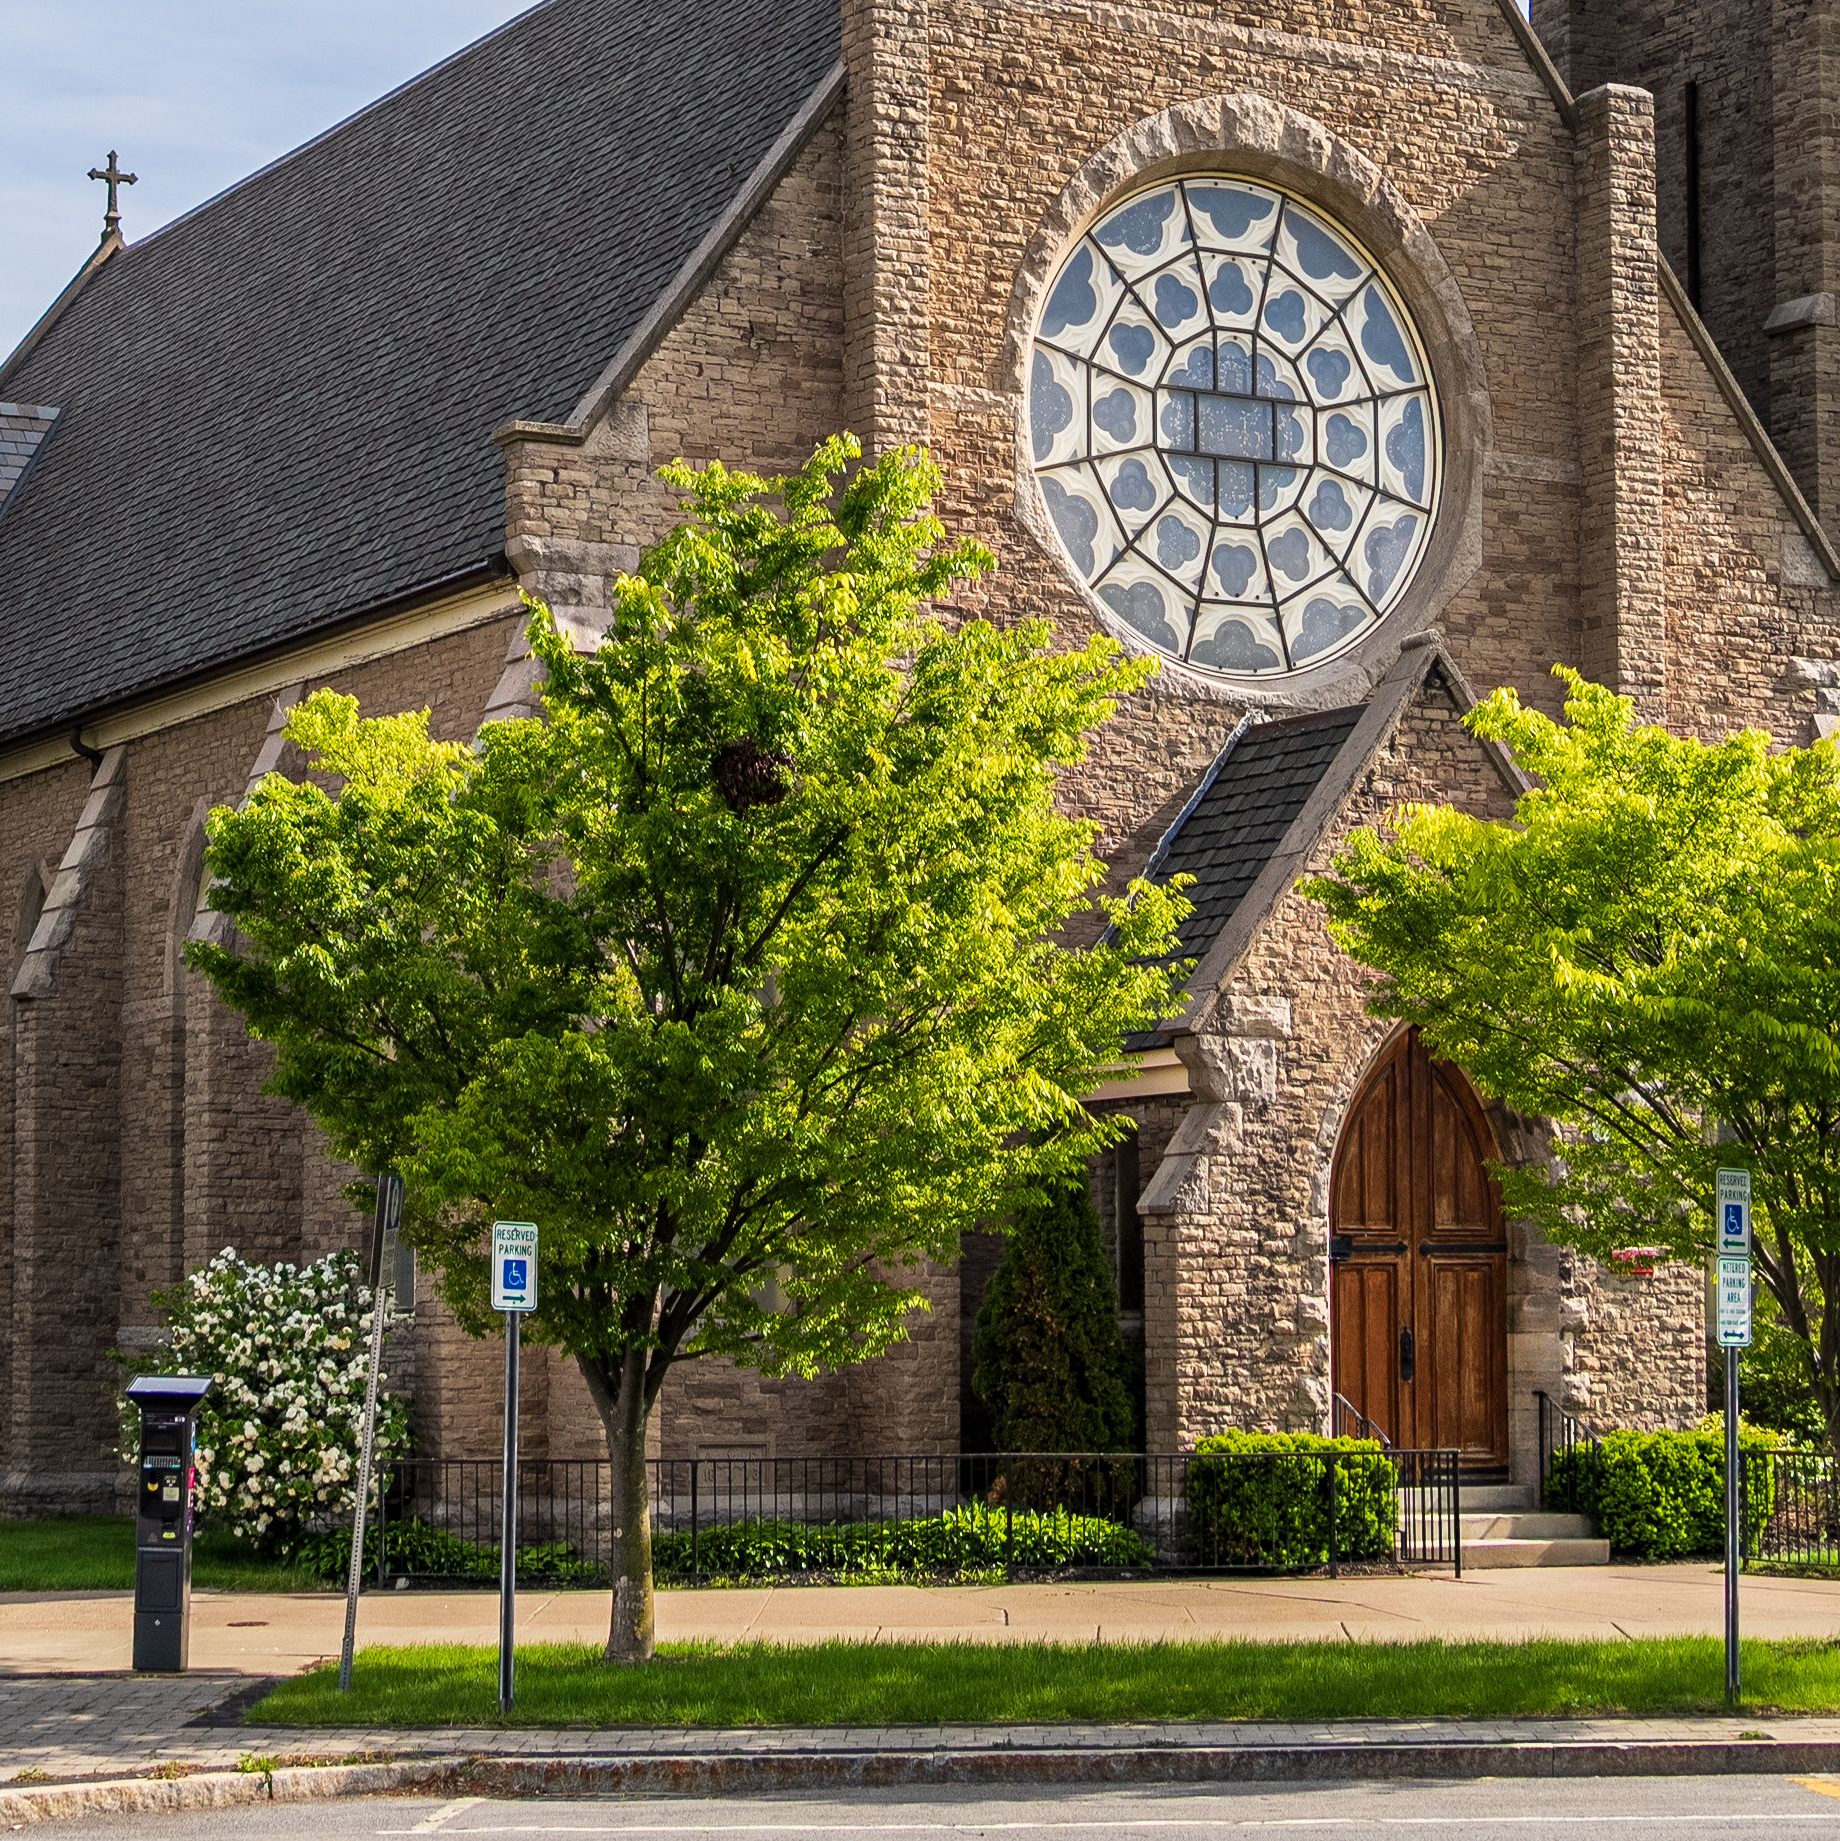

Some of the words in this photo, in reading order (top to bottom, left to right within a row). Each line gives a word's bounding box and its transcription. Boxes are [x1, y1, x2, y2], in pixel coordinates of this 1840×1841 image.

[1720, 1189, 1747, 1202] PARKING
[497, 1229, 535, 1241] RESERVED
[498, 1243, 532, 1256] PARKING
[1722, 1262, 1746, 1274] METERED
[1722, 1277, 1746, 1289] PARKING
[1727, 1292, 1741, 1303] AREA
